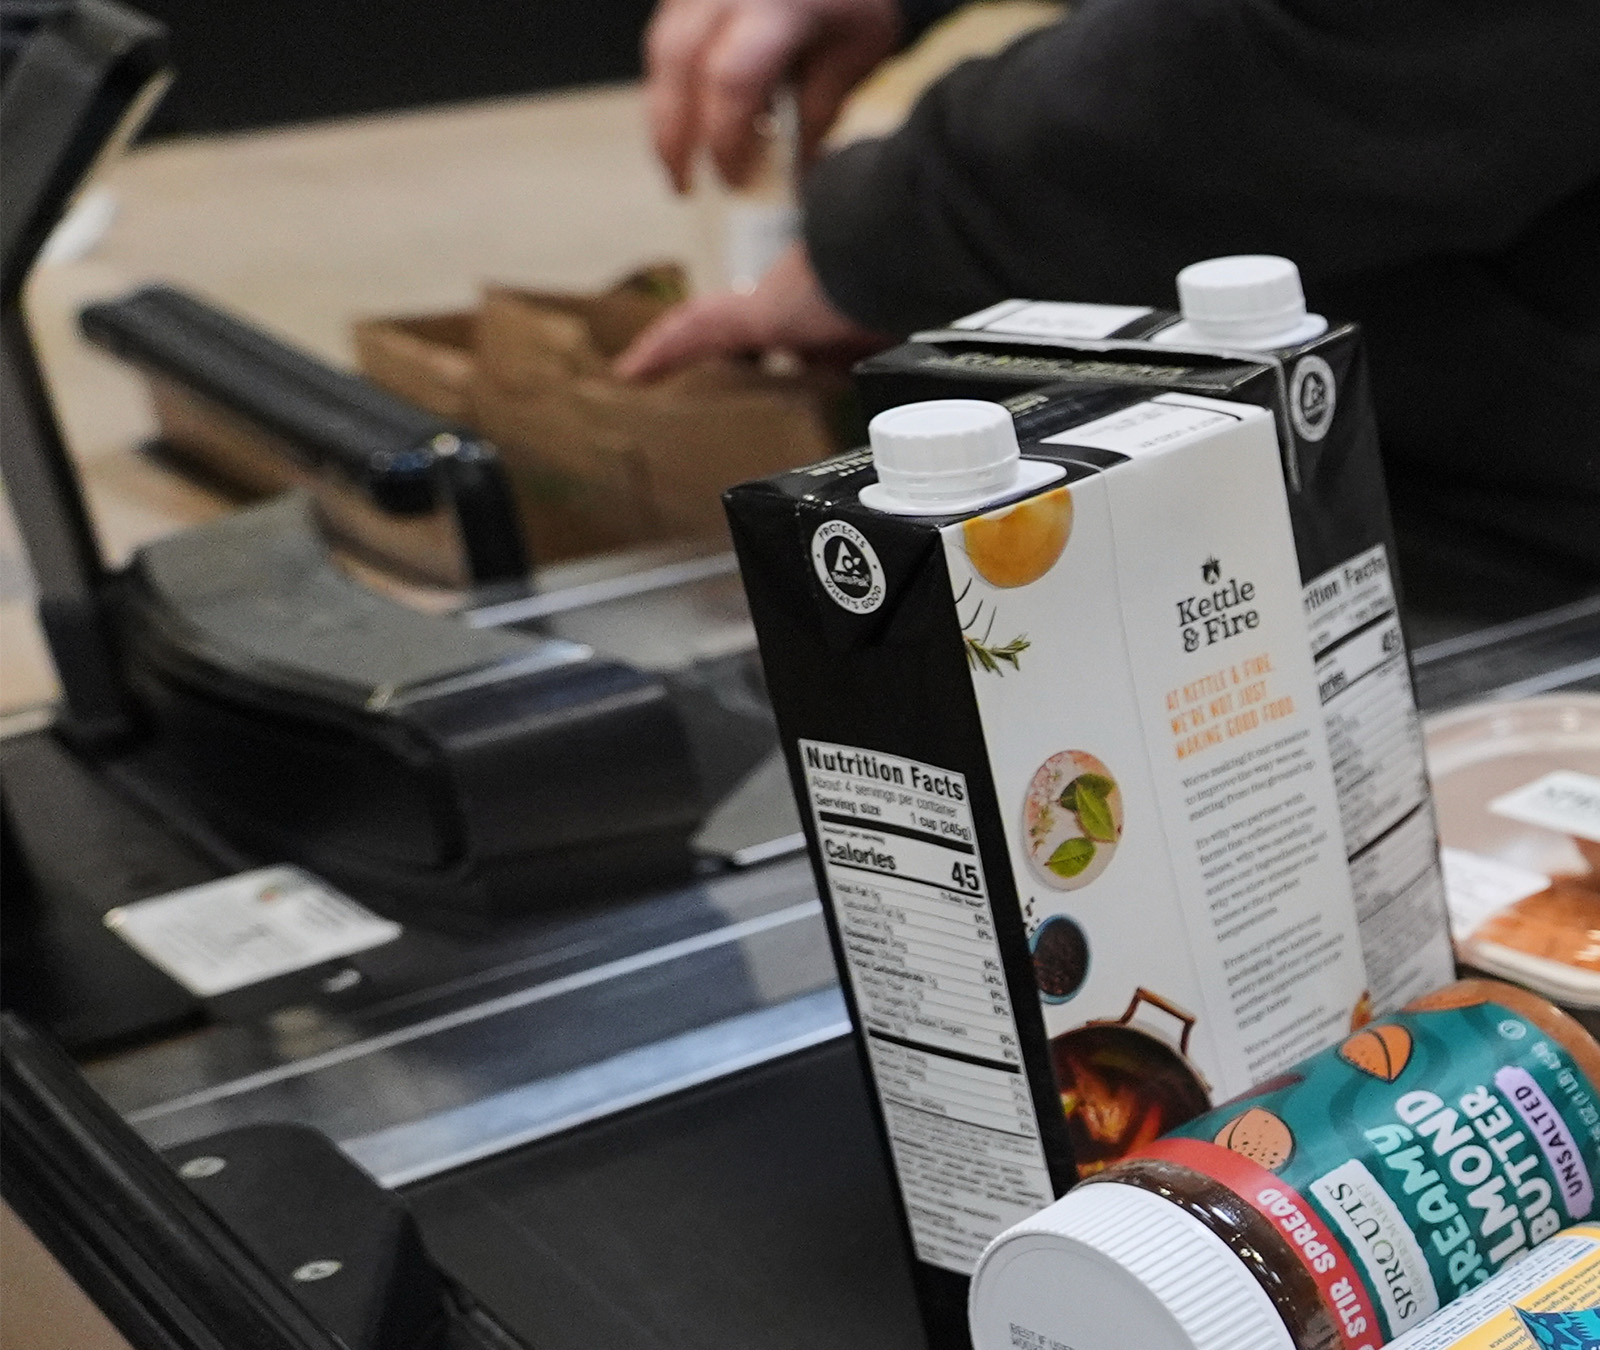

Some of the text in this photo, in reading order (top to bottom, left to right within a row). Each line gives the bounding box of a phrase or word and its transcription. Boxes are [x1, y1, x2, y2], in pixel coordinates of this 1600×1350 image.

[818, 524, 865, 548] PROTECTS
[1177, 579, 1255, 627] Kettle
[1183, 610, 1260, 653] & Fire
[807, 746, 963, 800] Nutrition Facts
[825, 838, 980, 891] Calories 45
[1395, 1090, 1530, 1266] LMOND
[1460, 1085, 1561, 1245] BUTTER
[1515, 1085, 1583, 1197] UNSALTED
[1256, 1188, 1367, 1338] STIR SPREAD
[1330, 1182, 1418, 1319] SPROUTS
